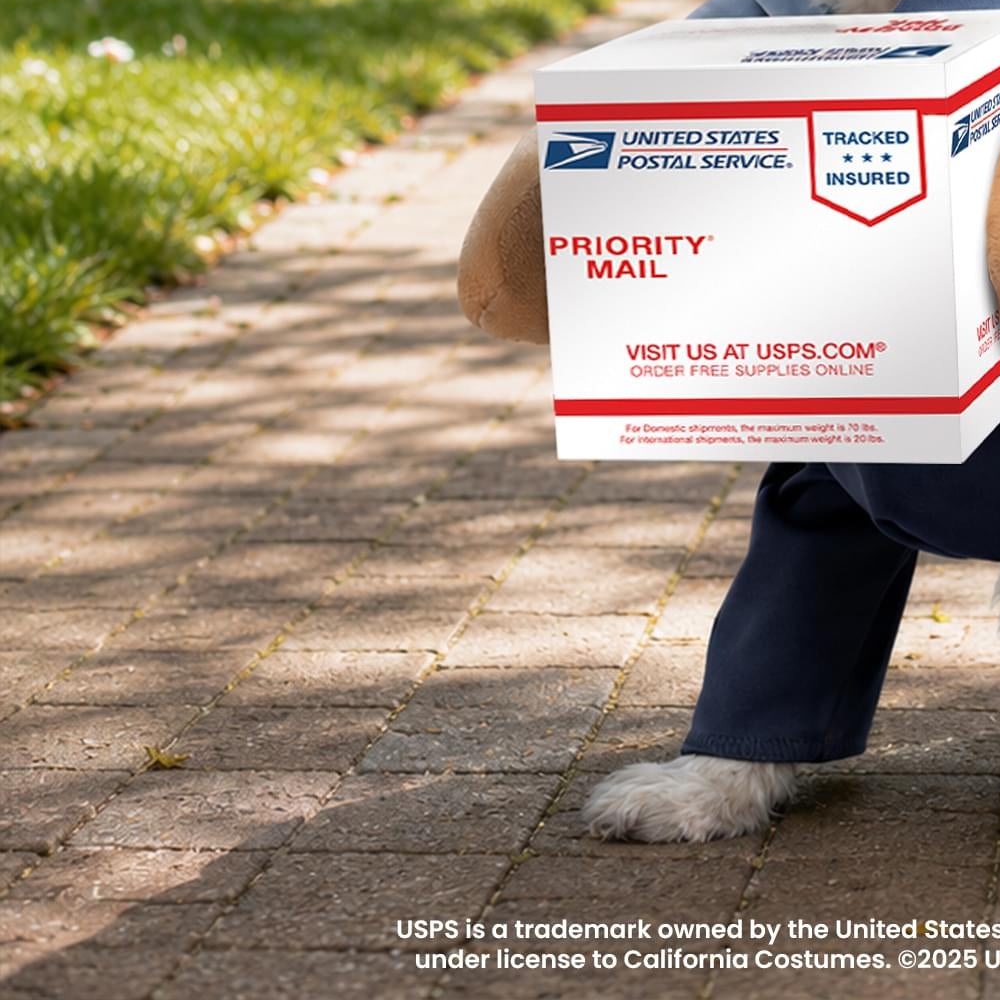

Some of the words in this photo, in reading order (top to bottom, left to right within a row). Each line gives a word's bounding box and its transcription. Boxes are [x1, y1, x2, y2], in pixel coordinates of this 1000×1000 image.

[970, 99, 993, 122] UNITED
[622, 131, 702, 146] UNITED
[705, 130, 779, 145] STATES
[822, 131, 910, 145] TRACKED
[617, 154, 698, 170] POSTAL
[825, 171, 910, 186] INSURED
[586, 259, 668, 280] MAIL
[626, 344, 681, 361] VISIT
[686, 343, 717, 360] US
[723, 343, 750, 360] AT
[630, 365, 685, 378] ORDER
[690, 365, 729, 377] FREE
[735, 364, 810, 377] SUPPLIES
[815, 364, 873, 376] ONLINE
[625, 424, 641, 433] For
[643, 424, 686, 433] Domestic
[740, 423, 755, 433] the
[757, 424, 802, 432] maximum
[804, 423, 834, 433] weight
[837, 423, 845, 432] is
[619, 435, 635, 444] For
[637, 435, 693, 444] International
[695, 435, 745, 445] shipments,
[747, 435, 761, 444] the
[764, 435, 808, 443] maximum
[810, 434, 842, 445] weight
[844, 434, 852, 443] is
[854, 434, 866, 443] 20
